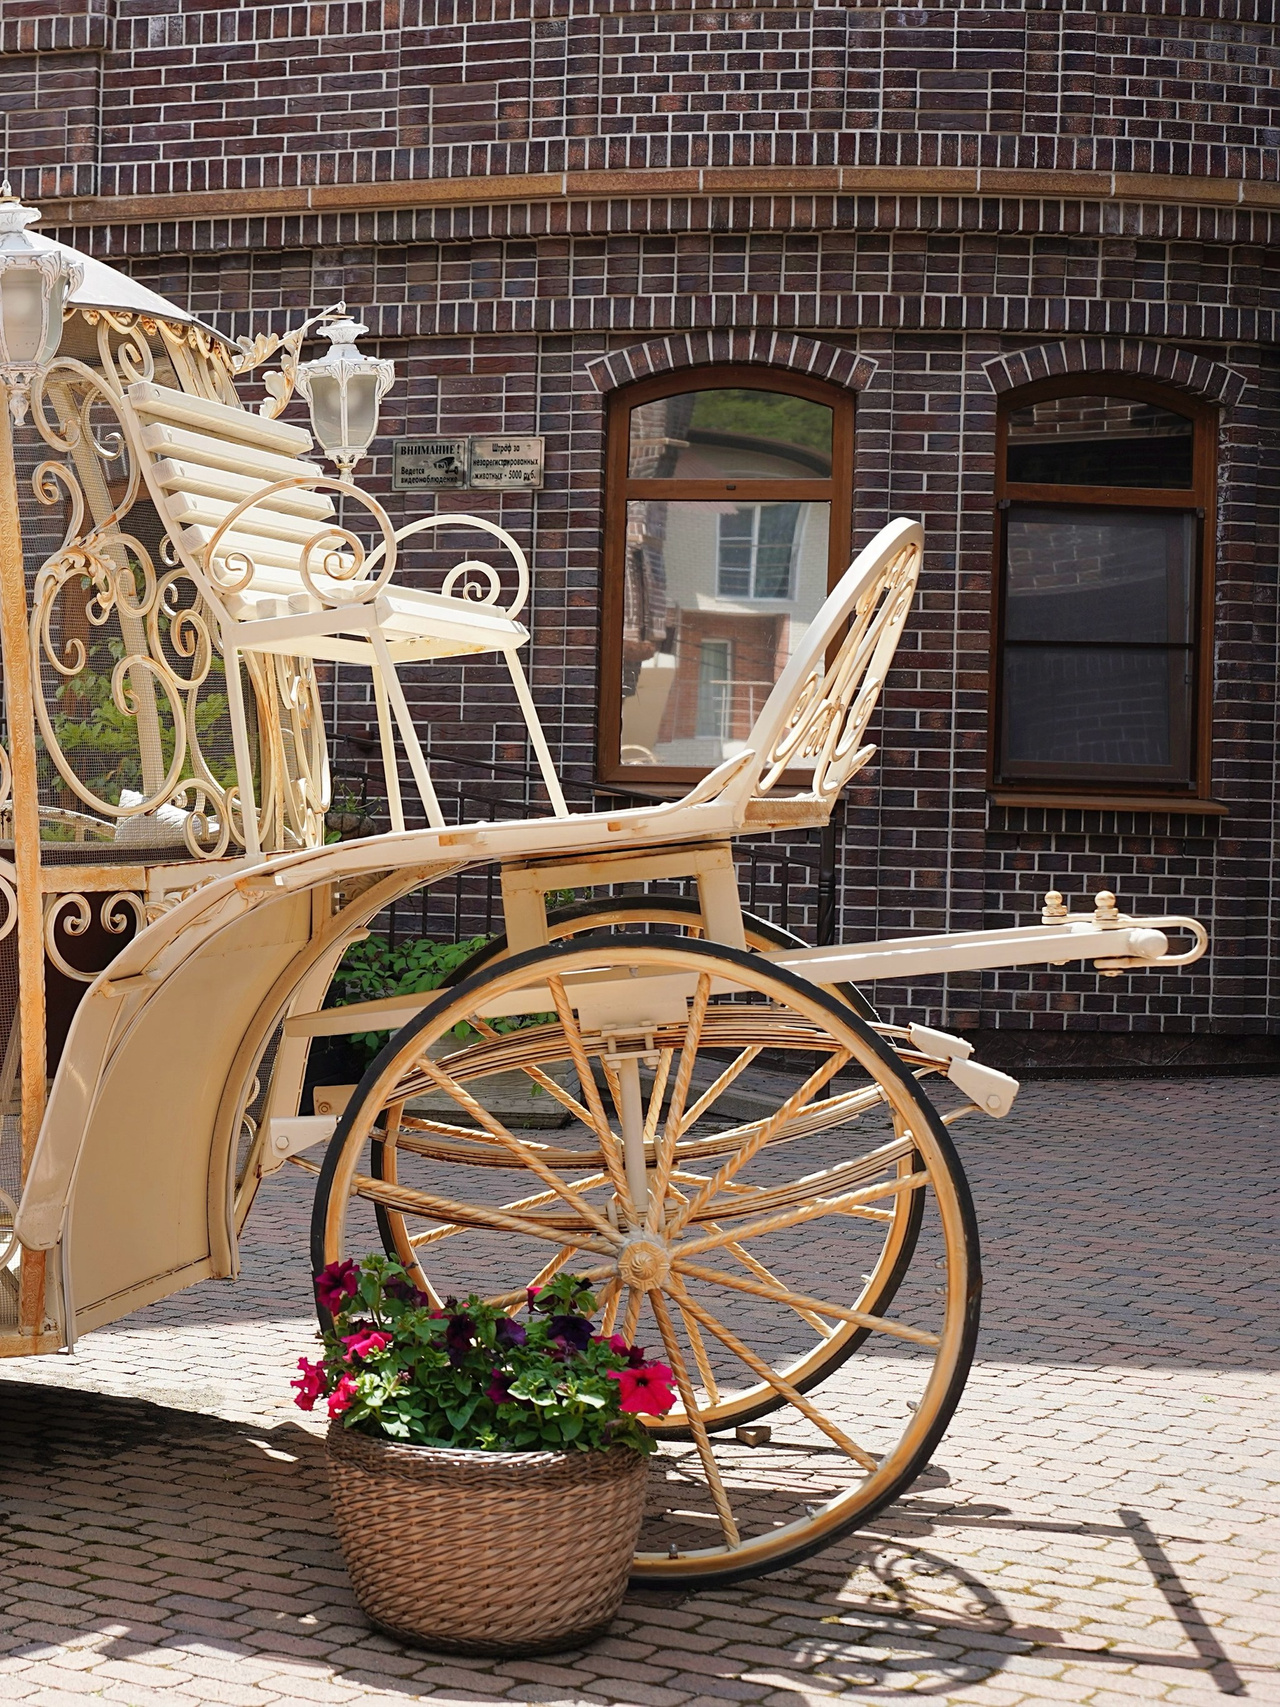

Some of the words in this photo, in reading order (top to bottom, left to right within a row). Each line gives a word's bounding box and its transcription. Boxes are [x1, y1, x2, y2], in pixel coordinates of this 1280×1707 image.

[492, 443, 512, 454] Штраф
[401, 466, 425, 475] Ведется
[473, 472, 503, 480] животных
[508, 470, 522, 479] 5000
[401, 475, 458, 484] видеонаблюдение
